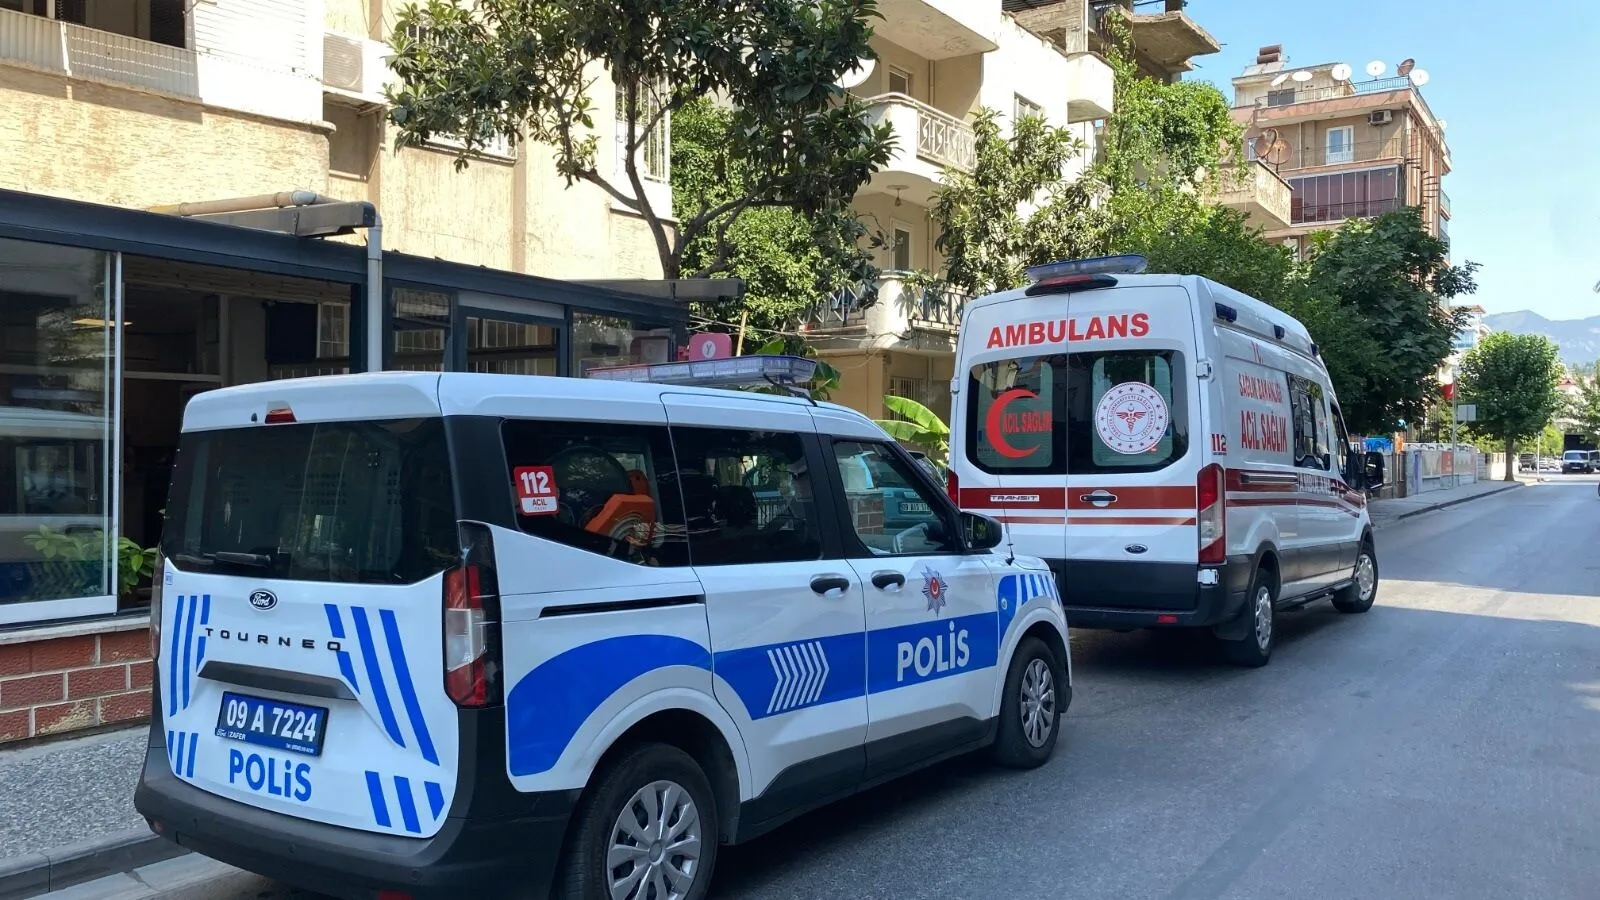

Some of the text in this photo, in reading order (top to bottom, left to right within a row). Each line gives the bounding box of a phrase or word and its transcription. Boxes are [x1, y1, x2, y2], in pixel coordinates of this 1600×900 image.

[986, 313, 1150, 349] AMBULANS
[1211, 433, 1227, 451] 112
[520, 471, 551, 494] 112
[251, 591, 272, 607] Ford
[205, 627, 342, 652] TOURNEO
[227, 699, 318, 742] 09 A 7224
